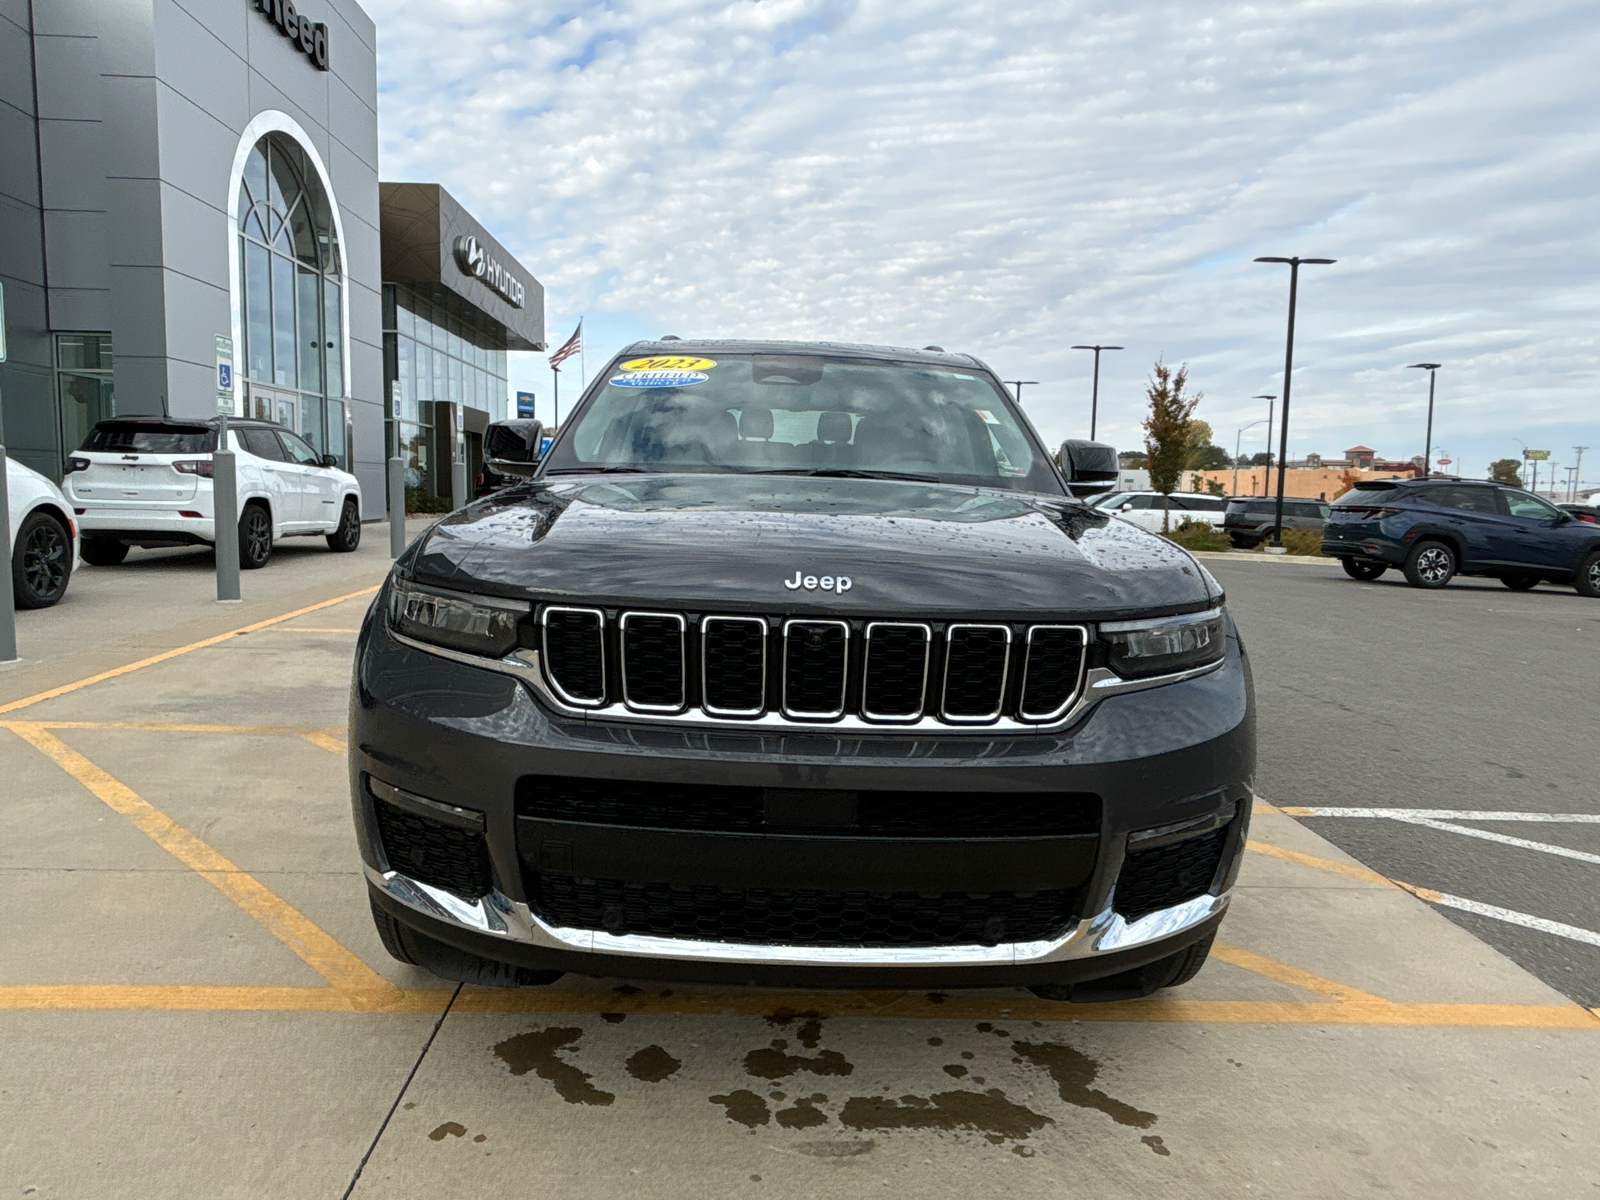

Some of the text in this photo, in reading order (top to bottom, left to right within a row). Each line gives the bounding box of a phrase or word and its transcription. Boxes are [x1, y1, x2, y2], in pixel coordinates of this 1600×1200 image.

[486, 254, 524, 308] HYUNDAI
[630, 359, 701, 368] 2023
[623, 372, 699, 380] CERTIFIED
[784, 571, 852, 594] Jeep
